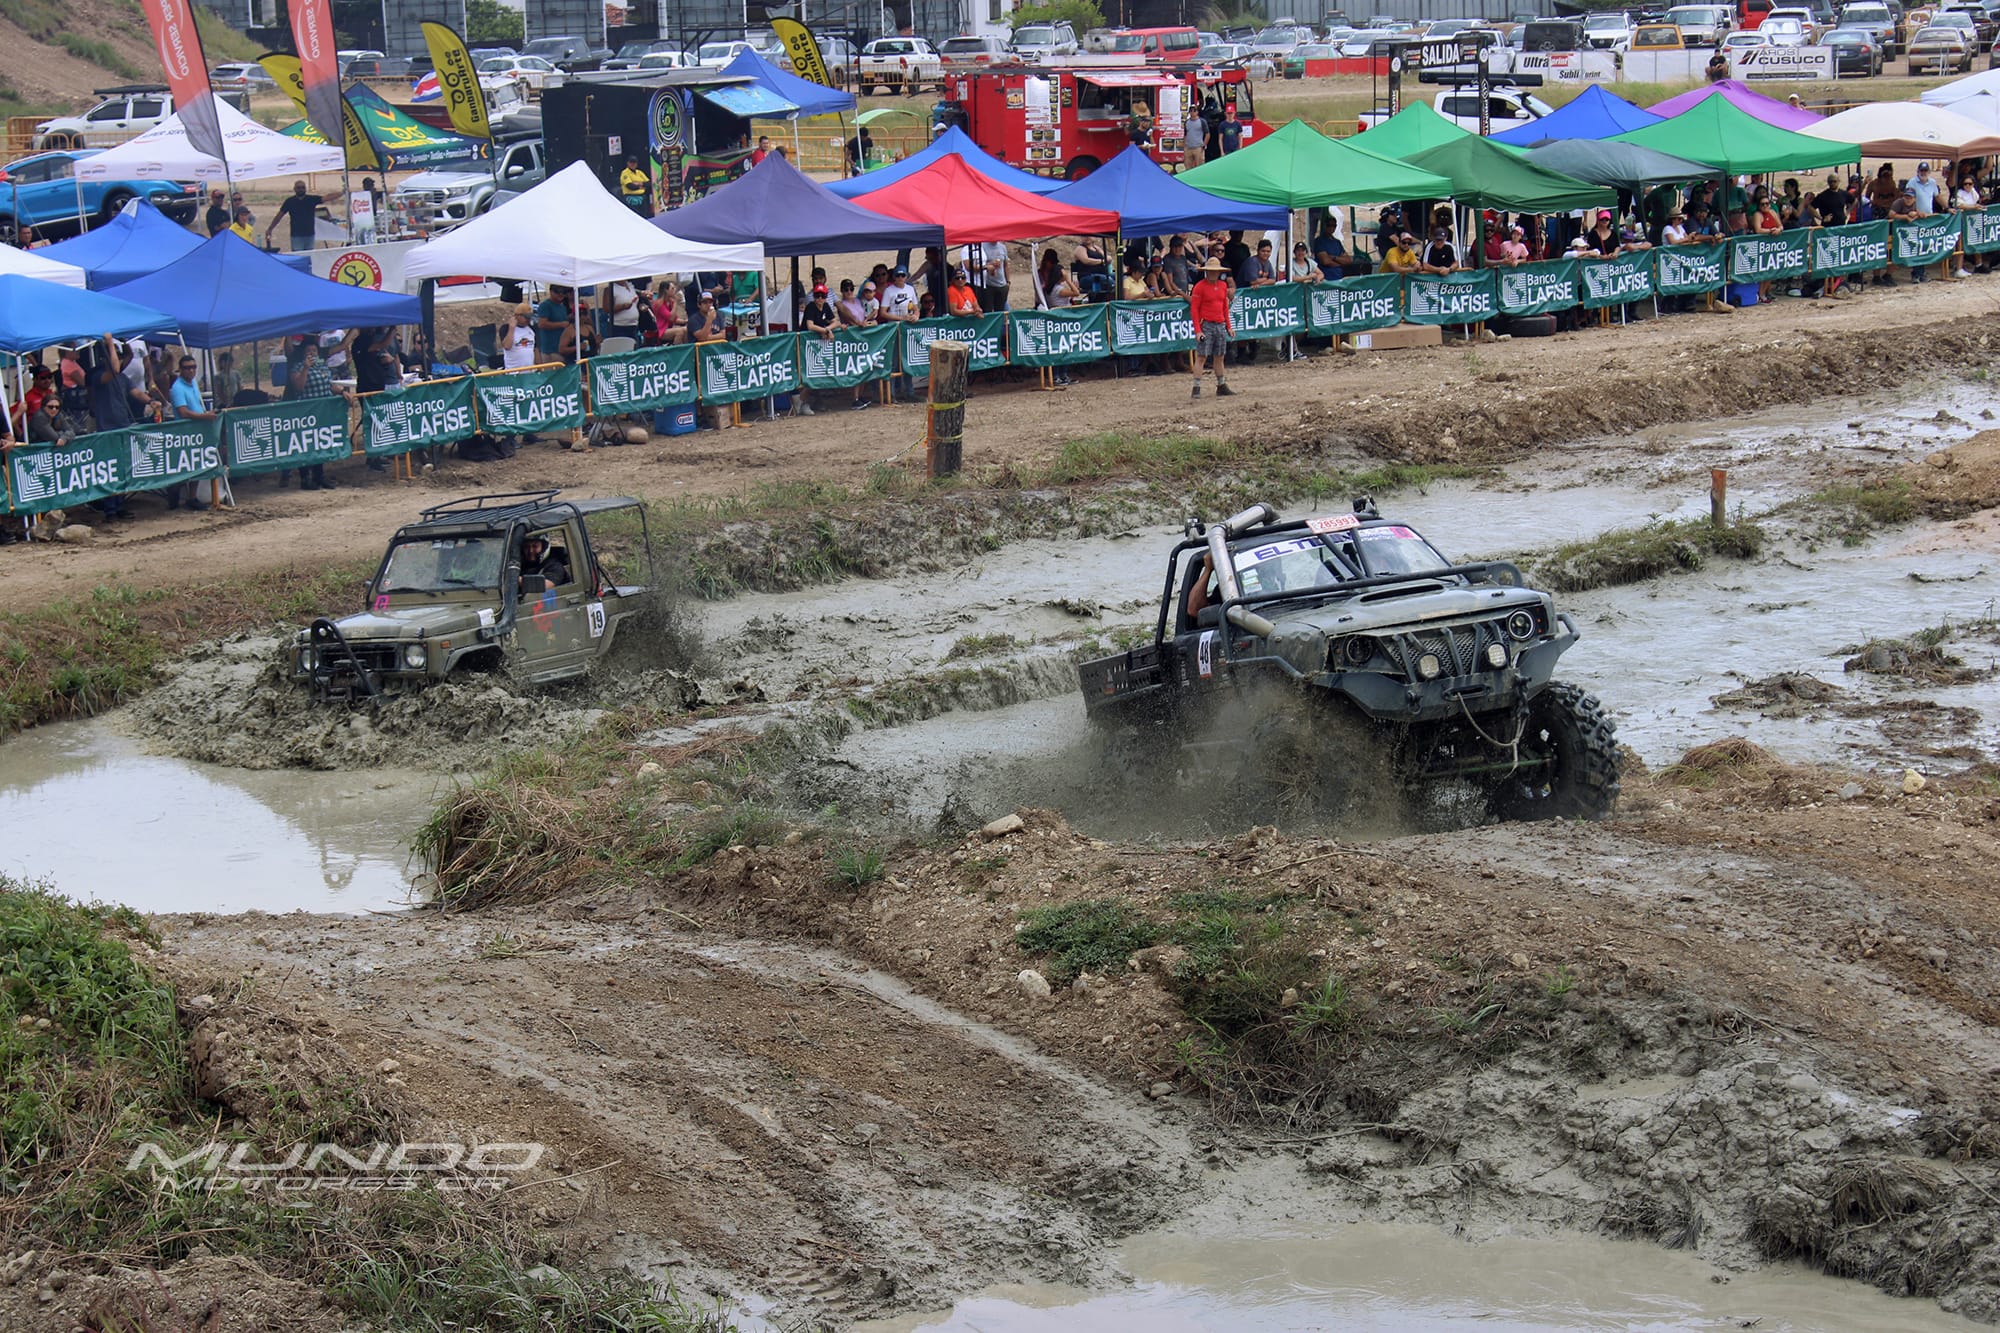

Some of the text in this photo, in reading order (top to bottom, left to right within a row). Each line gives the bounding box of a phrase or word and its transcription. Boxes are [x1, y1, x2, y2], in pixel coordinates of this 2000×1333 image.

[1422, 43, 1460, 66] SALIDA
[1759, 56, 1825, 65] CUSUCO
[1983, 214, 2000, 226] Banc
[1840, 235, 1868, 247] Banco
[1918, 226, 1947, 238] Banco
[1983, 225, 2000, 244] LAF
[1759, 240, 1787, 252] Banco
[1840, 242, 1887, 266] LAFISE
[1680, 254, 1705, 267] Banco
[1759, 248, 1803, 271] LAFISE
[1527, 273, 1556, 286] Banco
[1609, 263, 1634, 277] Banco
[1440, 283, 1473, 294] Banco
[1609, 271, 1649, 295] LAFISE
[1245, 296, 1277, 309] Banco
[1341, 288, 1374, 302] Banco
[1528, 281, 1573, 305] LAFISE
[1341, 297, 1394, 323] LAFISE
[1440, 293, 1490, 314] LAFISE
[1047, 320, 1081, 334] Banco
[1245, 307, 1298, 330] LAFISE
[939, 327, 976, 340] Banco
[1048, 331, 1102, 354] LAFISE
[835, 340, 868, 353] Banco
[969, 337, 998, 359] ISE
[629, 361, 667, 377] Banco
[737, 360, 793, 390] LAFISE
[630, 370, 690, 401] LAFISE
[406, 399, 445, 415] Banco
[516, 393, 579, 424] LAFISE
[273, 415, 316, 433] Banco
[408, 406, 470, 440] LAFISE
[165, 433, 203, 449] Banco
[275, 425, 343, 457] LAFISE
[55, 449, 93, 468] Banco
[166, 446, 218, 474] LAFIS
[56, 459, 118, 495] LAFISE
[591, 609, 604, 630] 19
[1200, 640, 1209, 665] 48
